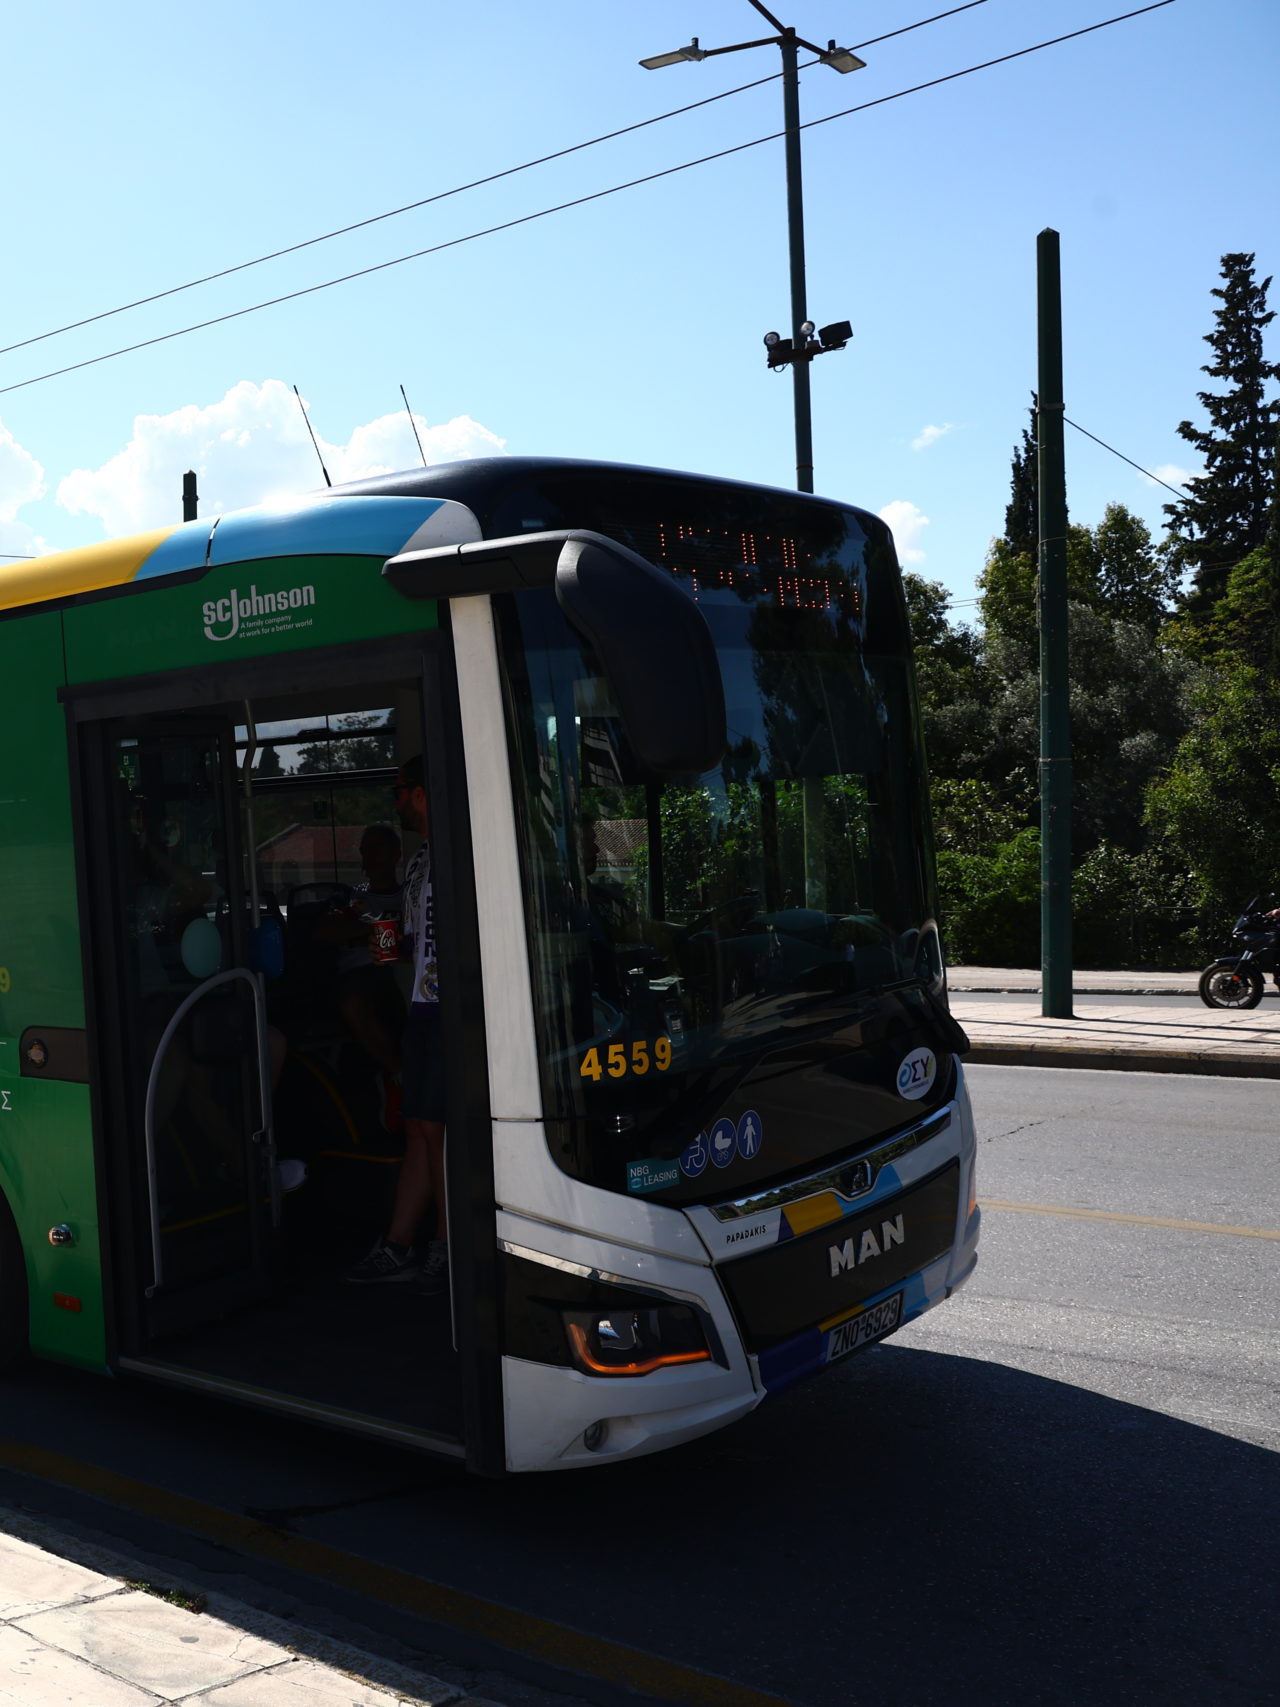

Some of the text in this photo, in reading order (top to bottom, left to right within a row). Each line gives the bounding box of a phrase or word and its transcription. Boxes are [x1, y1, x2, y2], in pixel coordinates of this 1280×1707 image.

[239, 631, 246, 639] at
[246, 628, 261, 639] work
[261, 626, 271, 635] for
[276, 623, 294, 633] better
[295, 618, 313, 629] world
[246, 620, 264, 630] family
[265, 615, 292, 626] company
[580, 1036, 672, 1082] 4559
[630, 1165, 650, 1178] NBG
[643, 1169, 678, 1187] LEASING
[726, 1224, 767, 1244] PAPADAKIS
[828, 1213, 905, 1278] MAN
